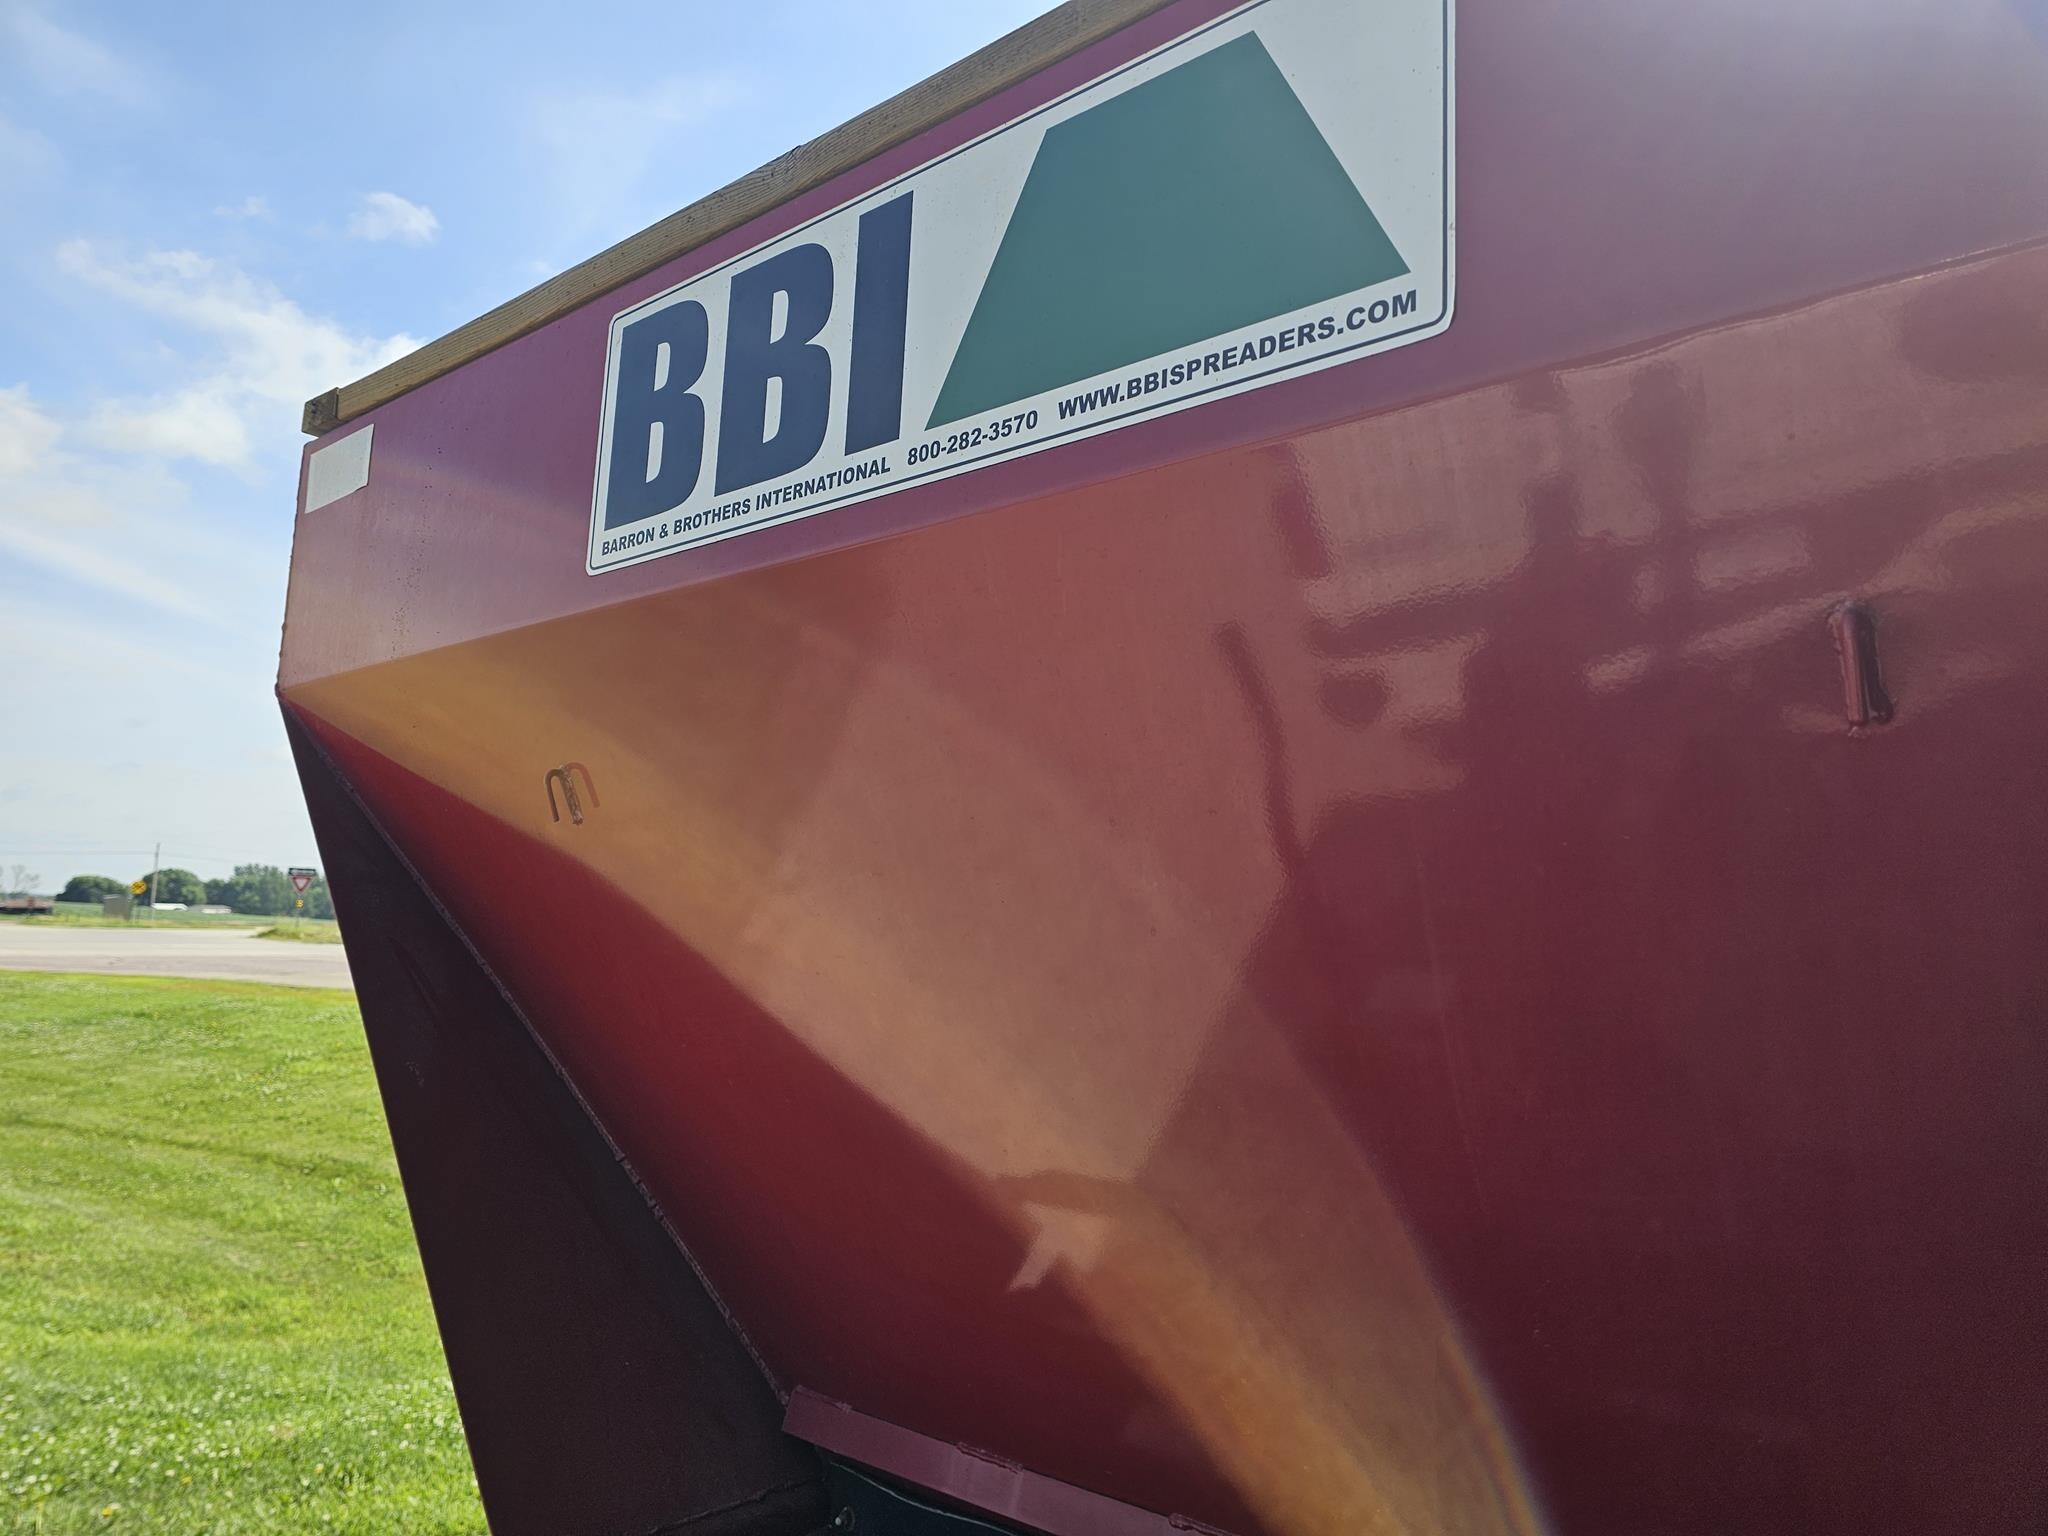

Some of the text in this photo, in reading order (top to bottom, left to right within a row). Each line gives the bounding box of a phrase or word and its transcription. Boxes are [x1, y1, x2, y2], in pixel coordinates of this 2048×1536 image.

[602, 289, 1418, 556] BARRON & BROTHERS INTERNATIONAL 800-282-3570 WWW.BBISPREADERS.COM
[604, 190, 914, 531] BBI
